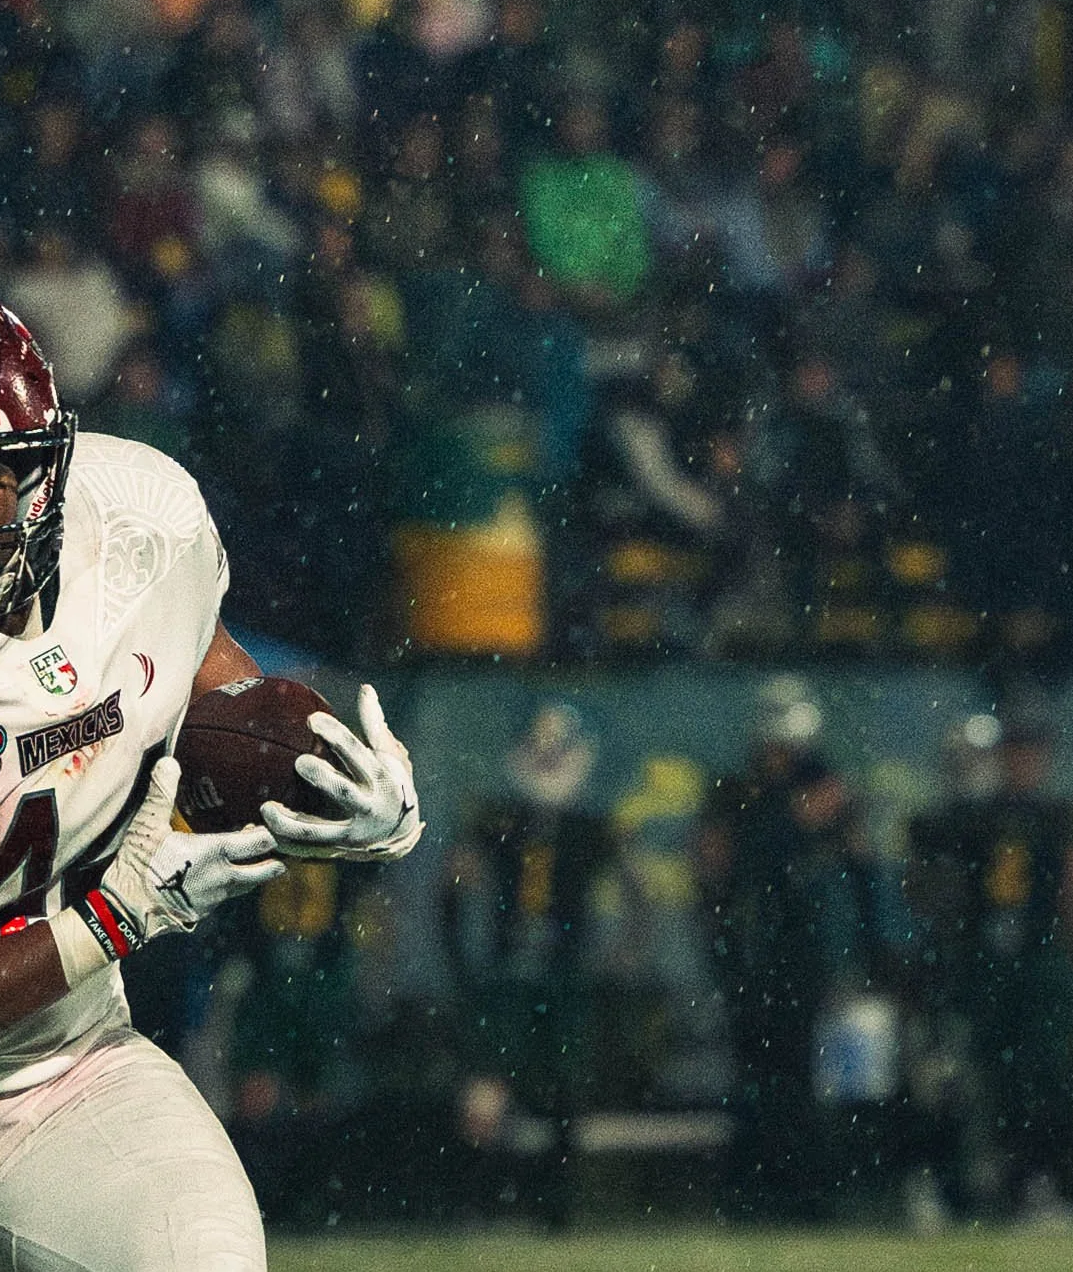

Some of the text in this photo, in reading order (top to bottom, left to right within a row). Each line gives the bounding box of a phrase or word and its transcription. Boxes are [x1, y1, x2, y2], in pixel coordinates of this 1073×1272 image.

[34, 651, 63, 672] LFA
[16, 689, 124, 778] MEXICAS
[88, 916, 108, 941] TAKE
